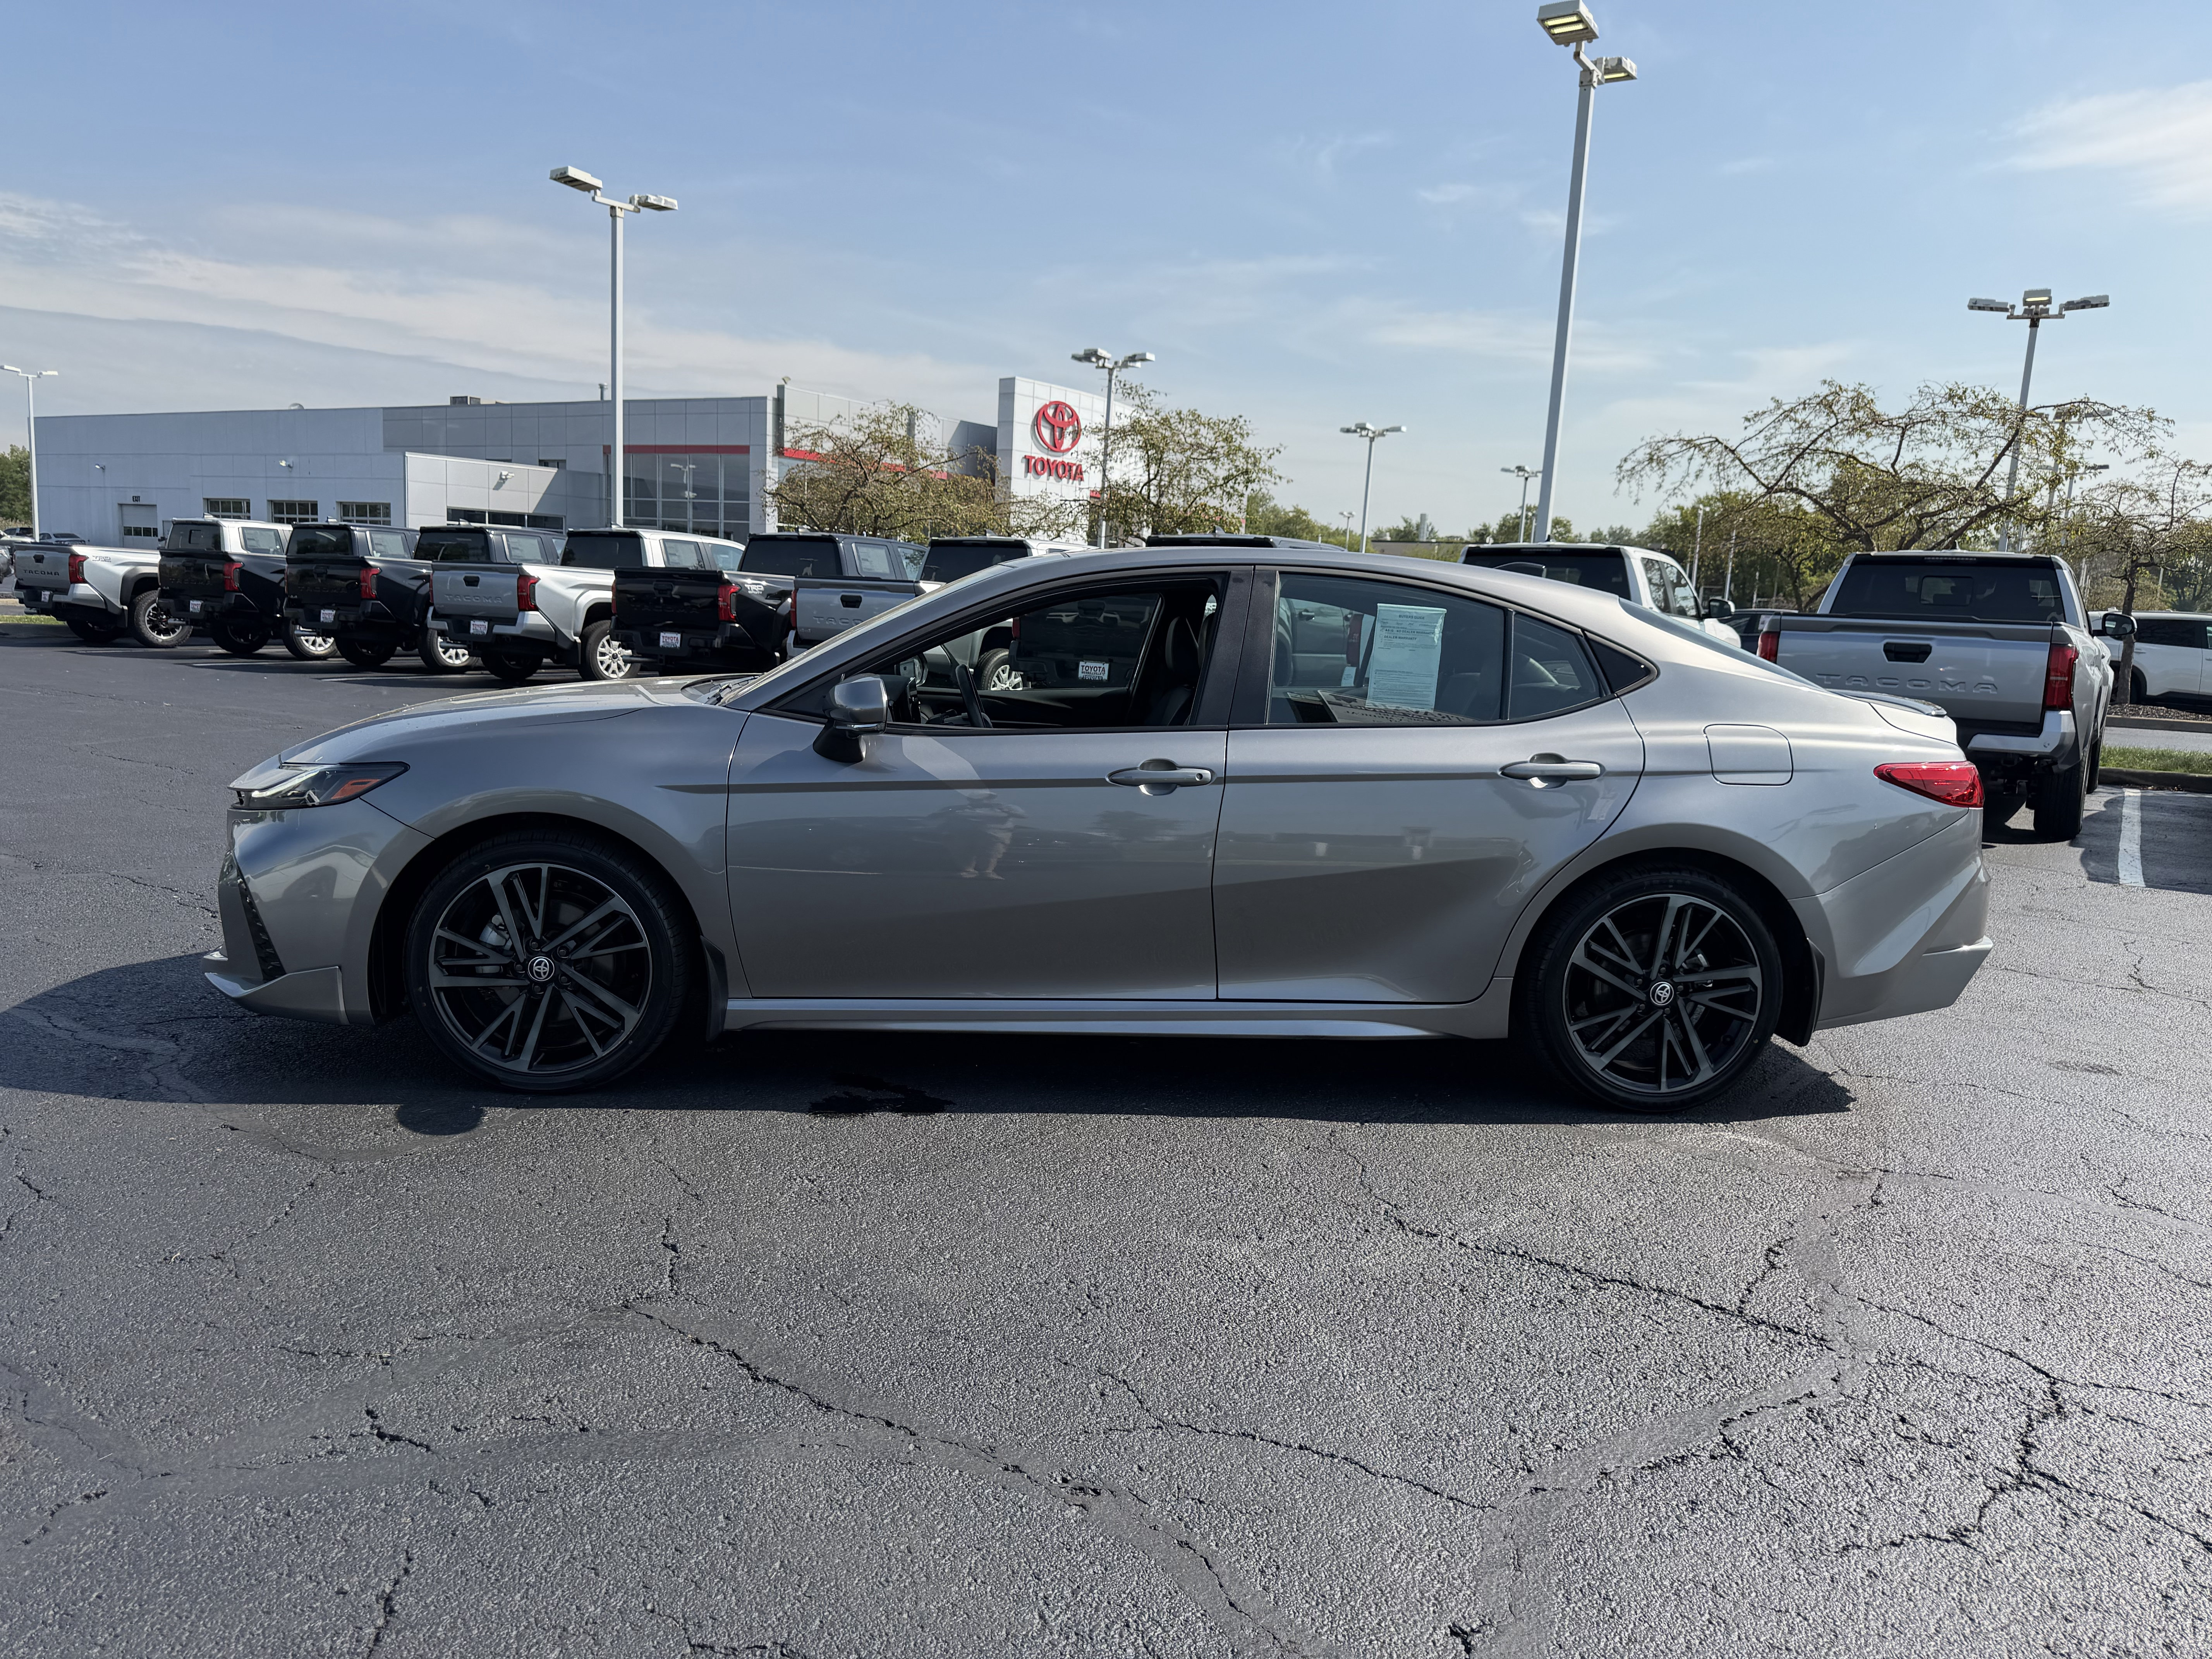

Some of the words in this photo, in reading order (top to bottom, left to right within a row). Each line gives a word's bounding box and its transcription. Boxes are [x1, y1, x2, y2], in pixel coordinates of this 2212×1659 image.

[1024, 455, 1084, 481] TOYOTA
[445, 594, 503, 603] TACOMA
[813, 616, 863, 626] TACO
[1816, 673, 1998, 694] TACOMA
